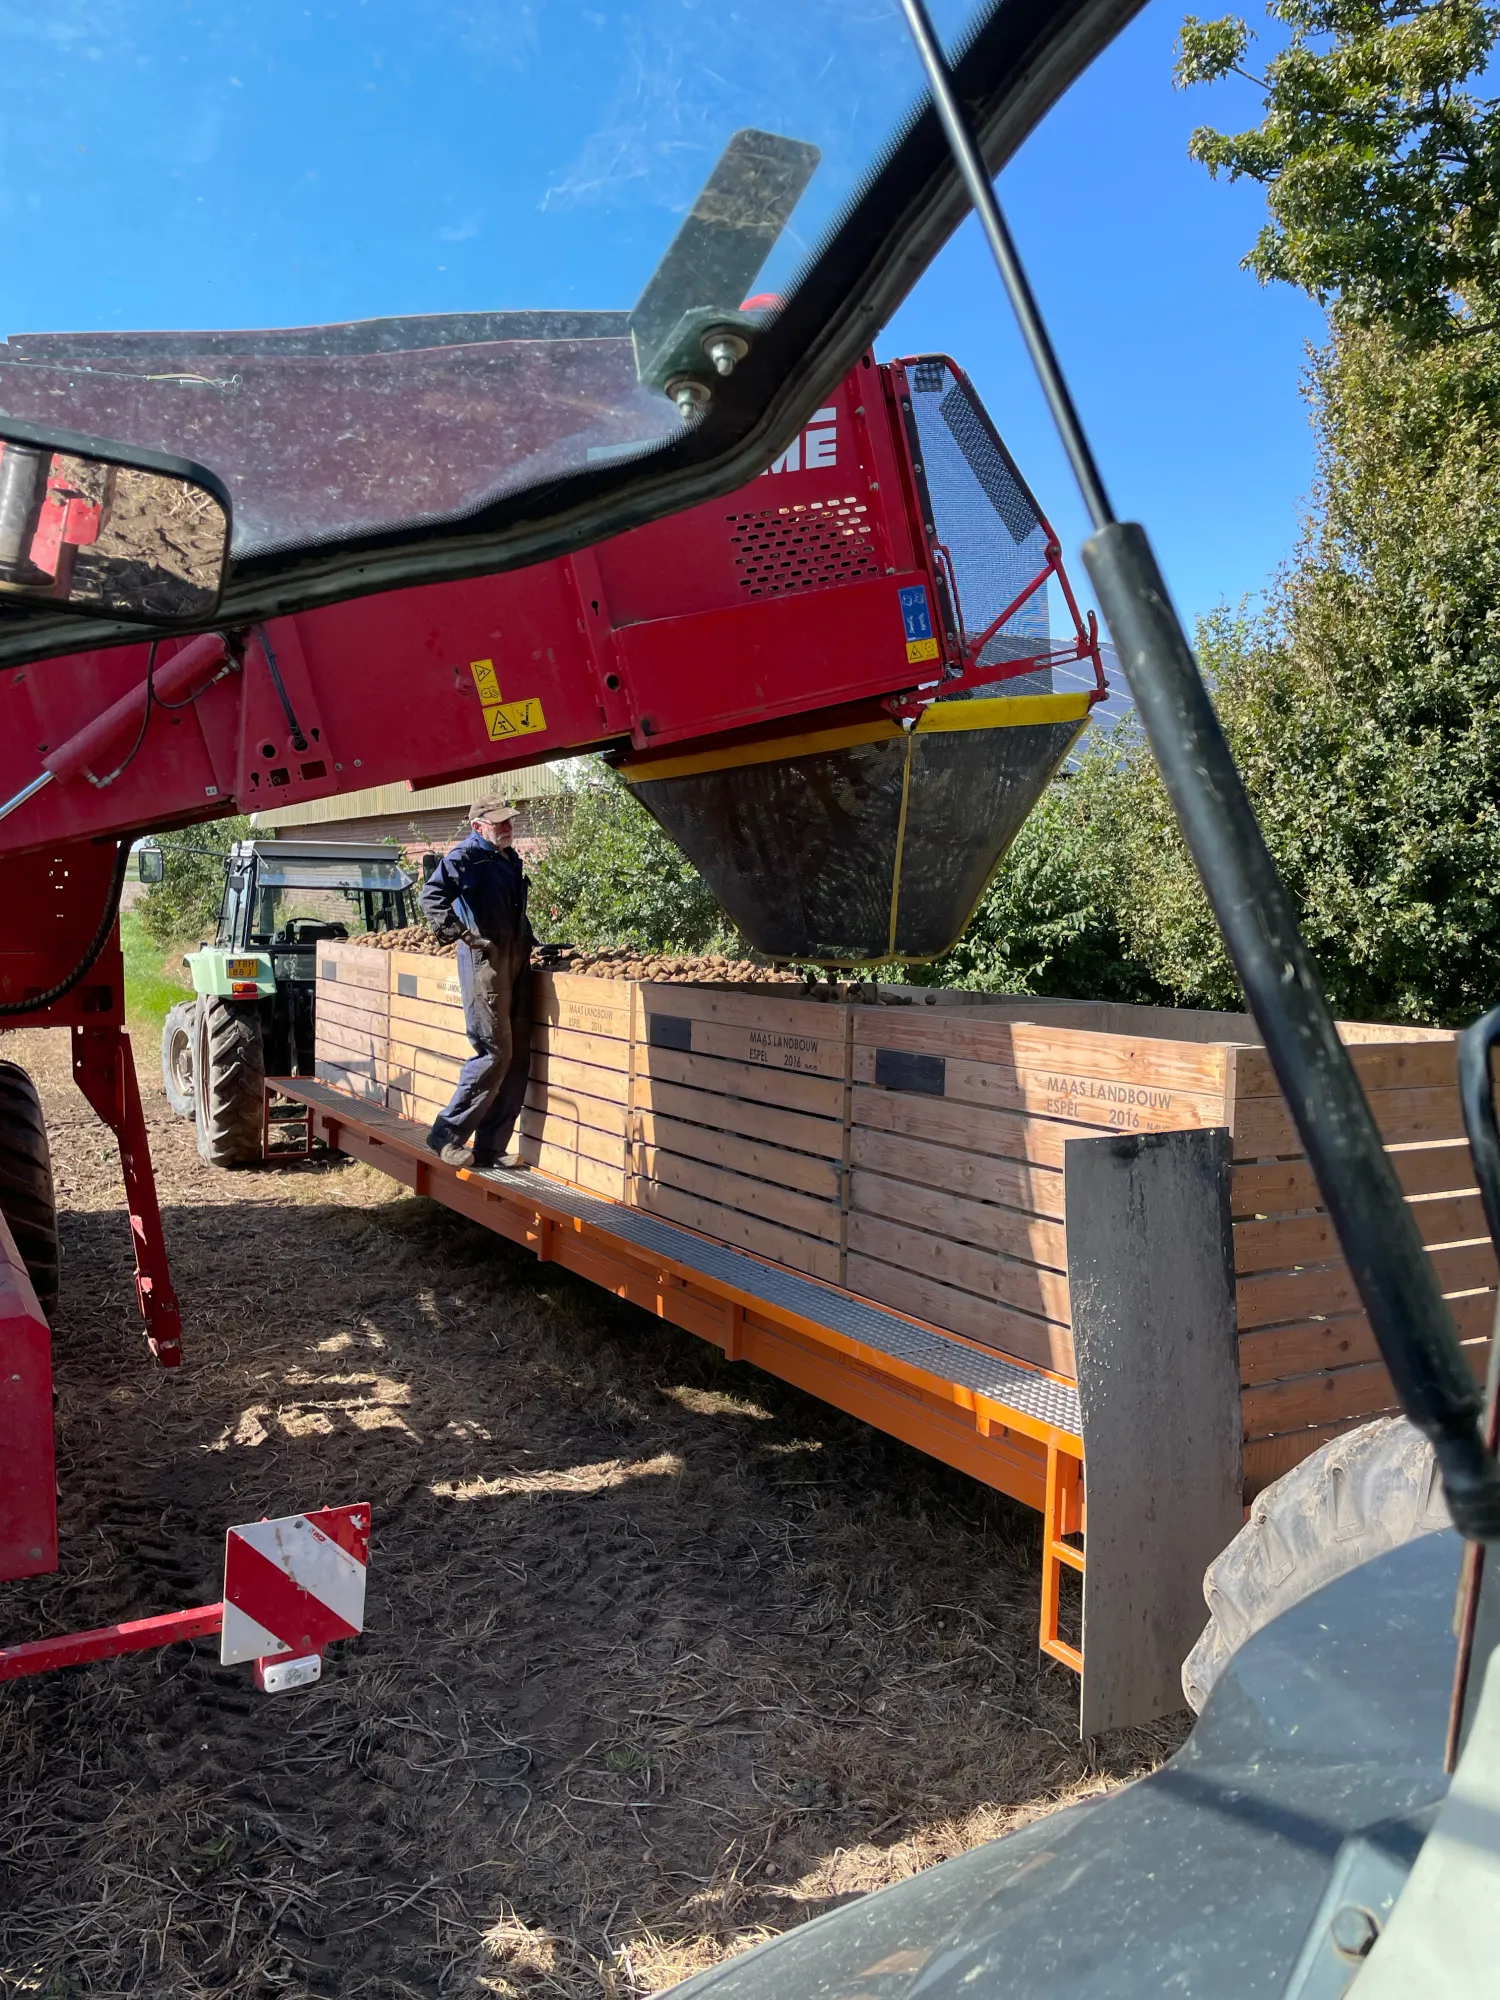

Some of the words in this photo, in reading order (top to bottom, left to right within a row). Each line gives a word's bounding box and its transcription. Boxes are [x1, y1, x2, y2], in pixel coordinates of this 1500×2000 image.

[233, 968, 244, 976] 88
[237, 960, 254, 968] TBH
[569, 1004, 583, 1014] MAAS
[584, 1006, 614, 1020] LANDBOUW
[569, 1017, 581, 1029] ESPEL
[591, 1021, 603, 1033] 2016
[749, 1031, 772, 1046] MAAS
[773, 1035, 819, 1053] LANDBOUW
[749, 1048, 768, 1062] ESPEL
[783, 1054, 801, 1068] 2016
[1047, 1076, 1086, 1096] MAAS
[1090, 1082, 1172, 1110] LANDBOUW
[1046, 1099, 1079, 1118] ESPEL
[1108, 1109, 1140, 1128] 2016
